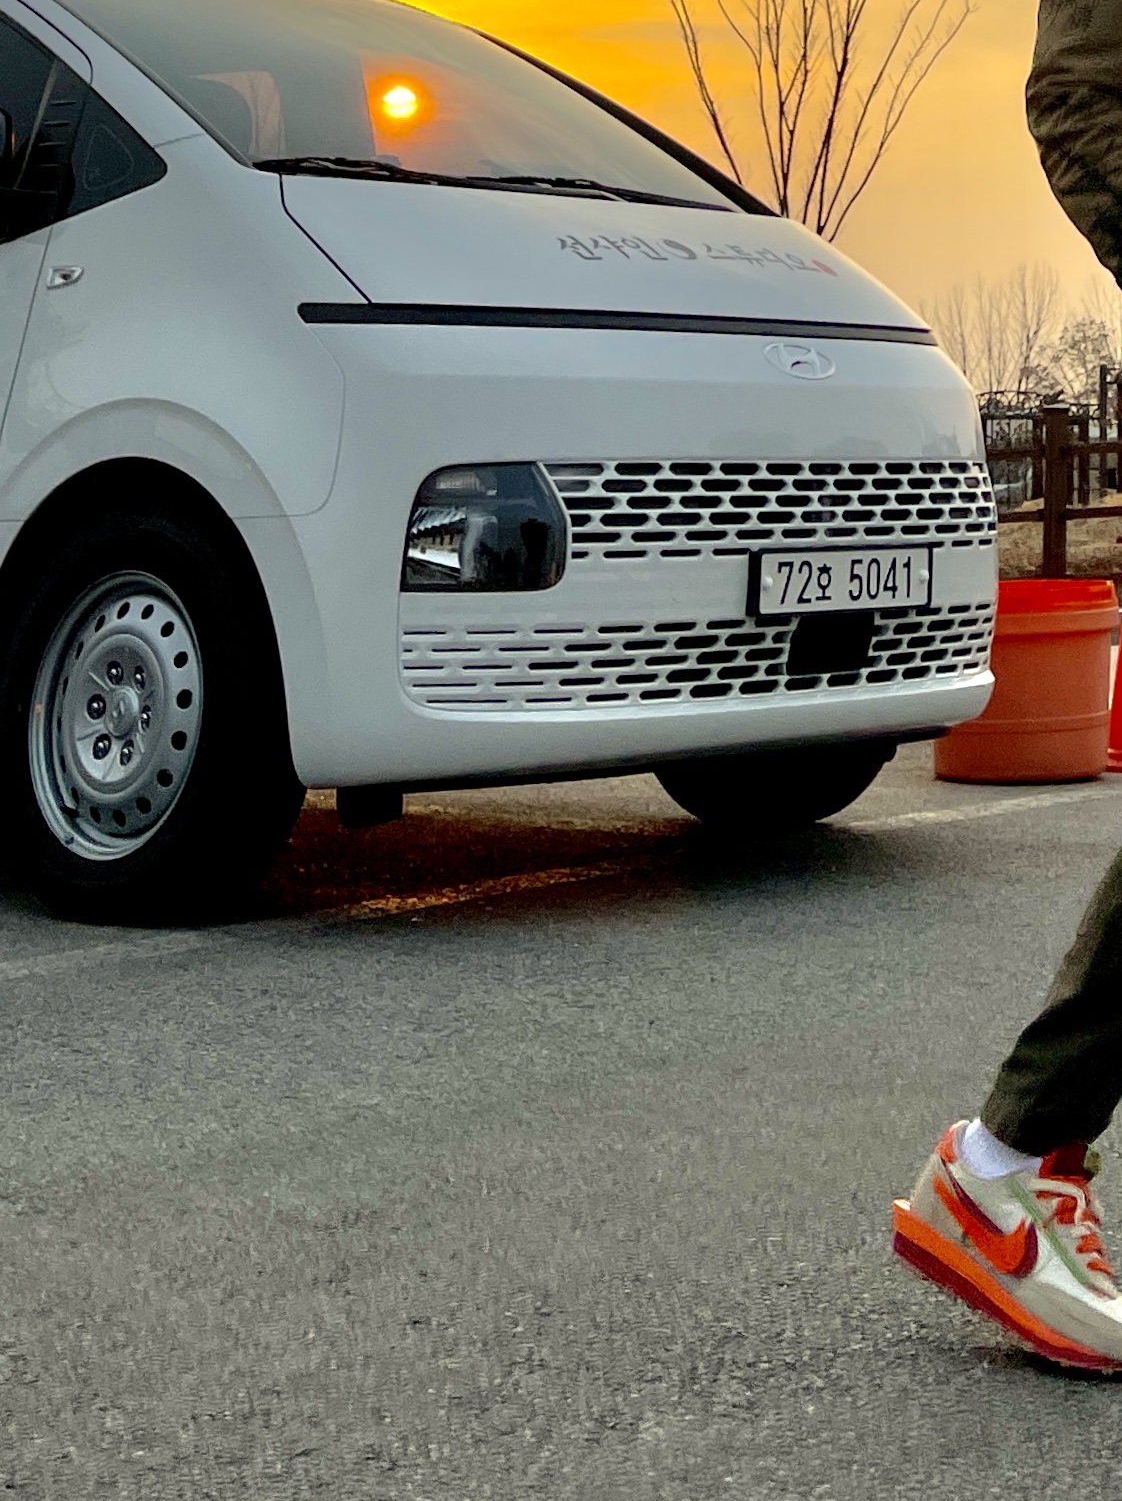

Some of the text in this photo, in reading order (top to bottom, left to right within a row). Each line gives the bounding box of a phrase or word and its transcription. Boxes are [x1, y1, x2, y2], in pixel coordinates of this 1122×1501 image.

[556, 234, 669, 261] 선샤인
[776, 555, 912, 606] 72호 5041
